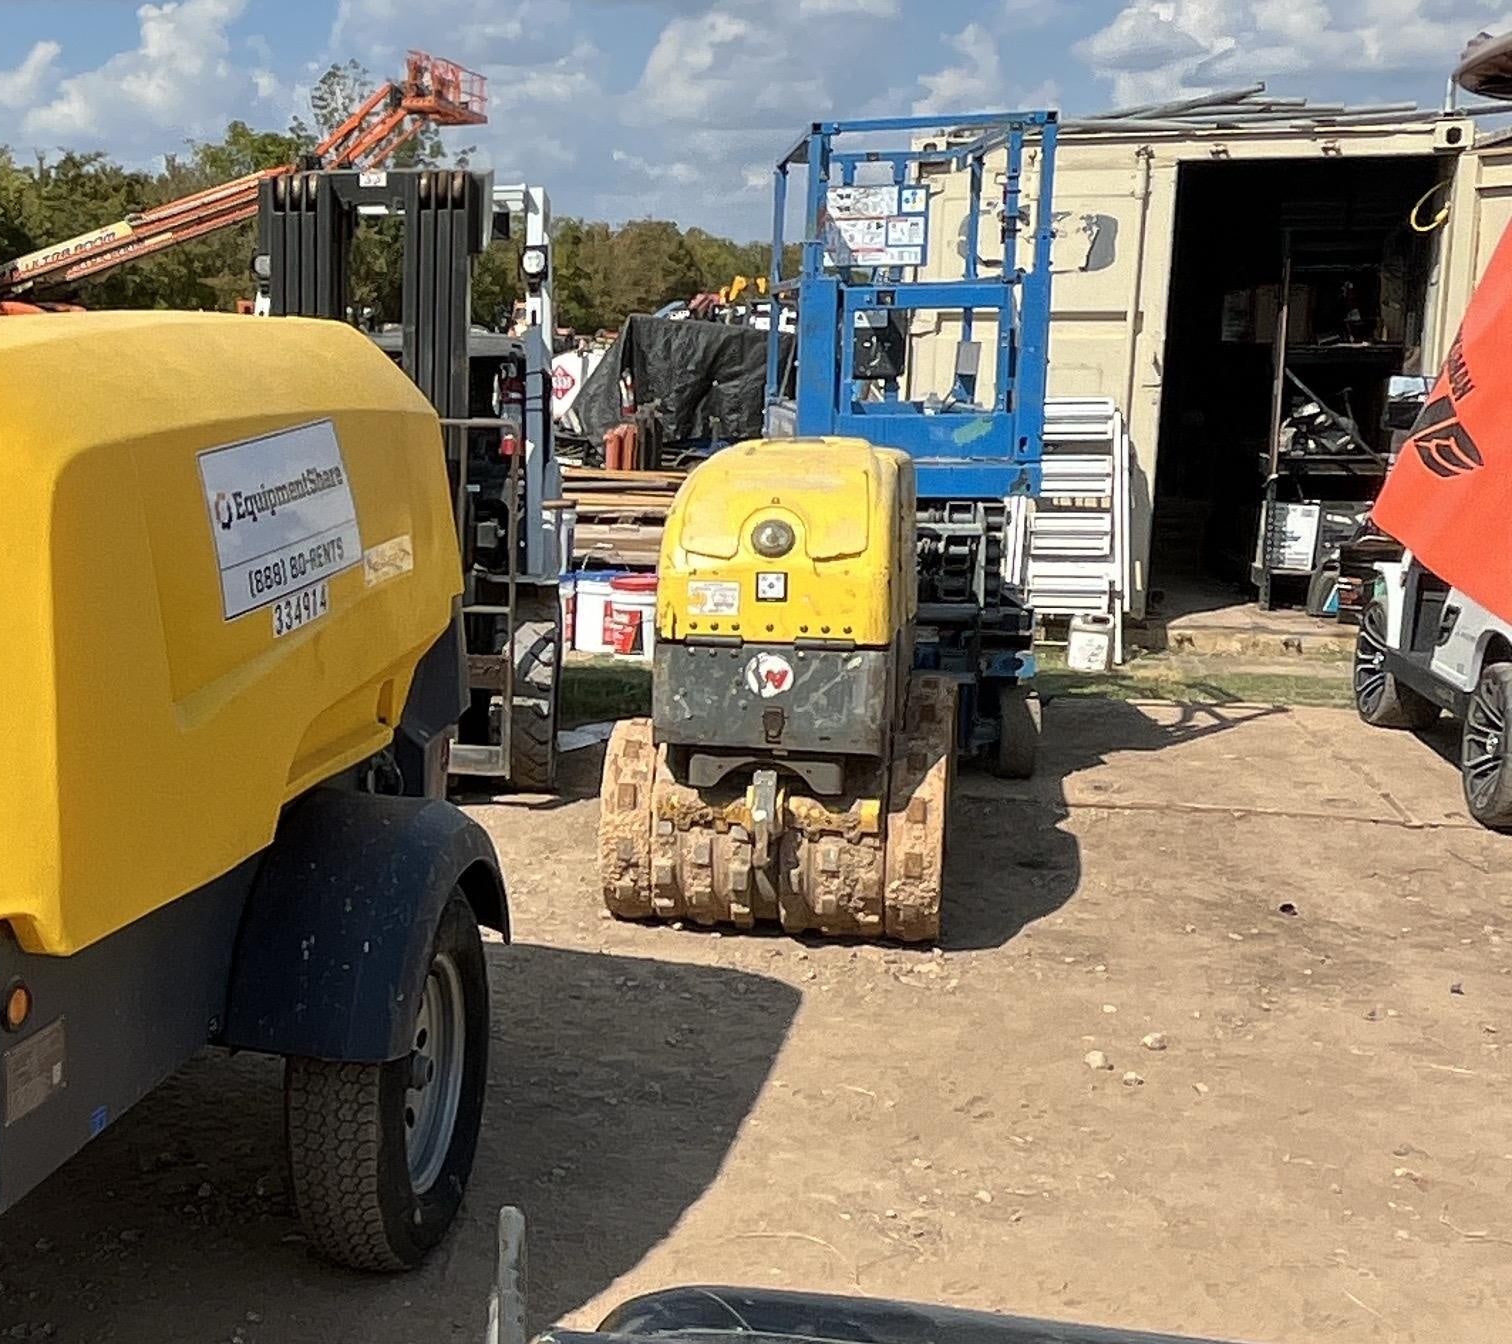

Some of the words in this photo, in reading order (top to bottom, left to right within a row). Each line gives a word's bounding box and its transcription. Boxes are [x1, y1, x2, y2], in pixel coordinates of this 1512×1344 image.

[232, 465, 344, 522] EquipmentShare
[247, 557, 288, 599] (888)
[289, 536, 345, 579] 80-RENTS
[272, 583, 329, 636] 334914
